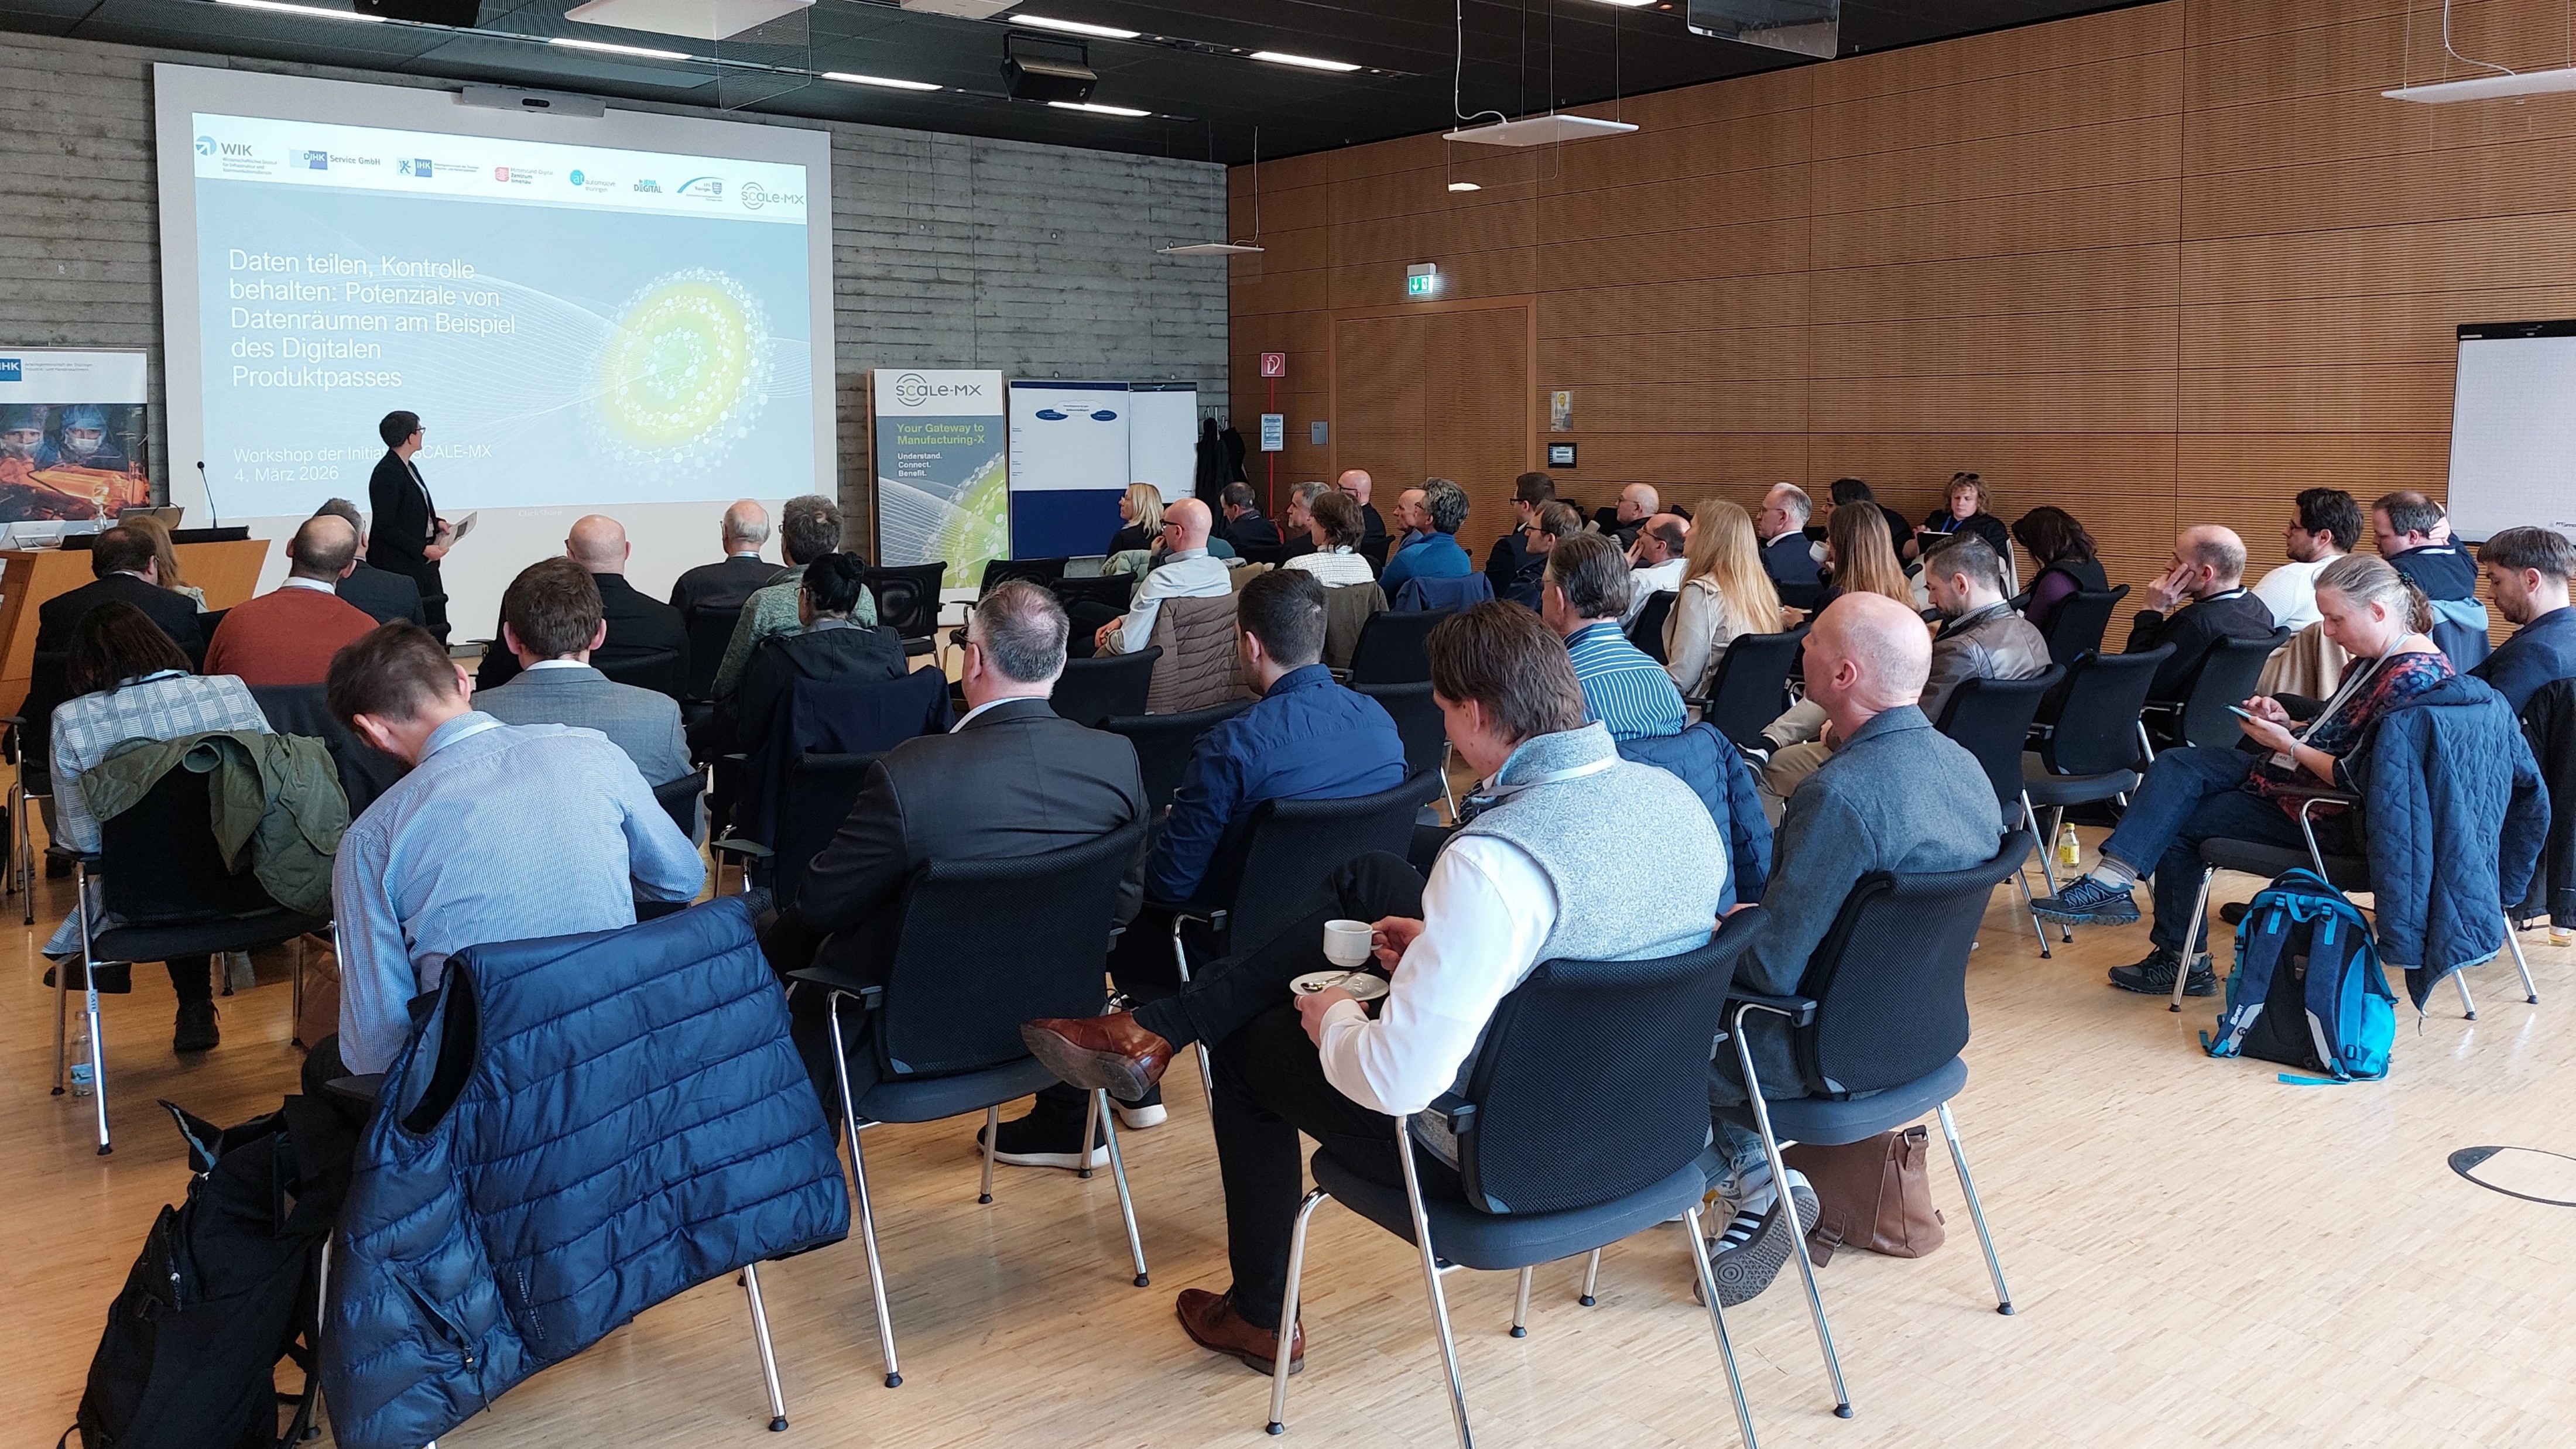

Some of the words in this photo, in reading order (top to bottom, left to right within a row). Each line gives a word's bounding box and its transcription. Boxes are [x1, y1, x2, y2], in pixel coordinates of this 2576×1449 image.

[221, 143, 252, 156] WIK
[330, 155, 356, 163] Service
[359, 156, 381, 165] GmbH
[229, 248, 299, 272] Daten
[307, 252, 373, 279] teilen,
[382, 255, 475, 279] Kontrolle
[229, 278, 337, 302] behalten:
[345, 282, 456, 306] Potenziale
[462, 291, 499, 307] von
[231, 307, 387, 331] Datenräumen
[395, 316, 427, 332] am
[436, 312, 515, 338] Beispiel
[231, 336, 275, 358] des
[283, 337, 381, 364] Digitalen
[233, 365, 402, 392] Produktpasses
[897, 424, 922, 433] Your
[925, 424, 971, 434] Gateway
[974, 423, 984, 432] to
[898, 435, 985, 446] Manufacturing-X
[234, 448, 313, 464] Workshop
[318, 447, 343, 461] der
[897, 452, 943, 460] Understand.
[235, 468, 249, 482] 4.
[255, 467, 294, 482] März
[299, 466, 339, 481] 2026
